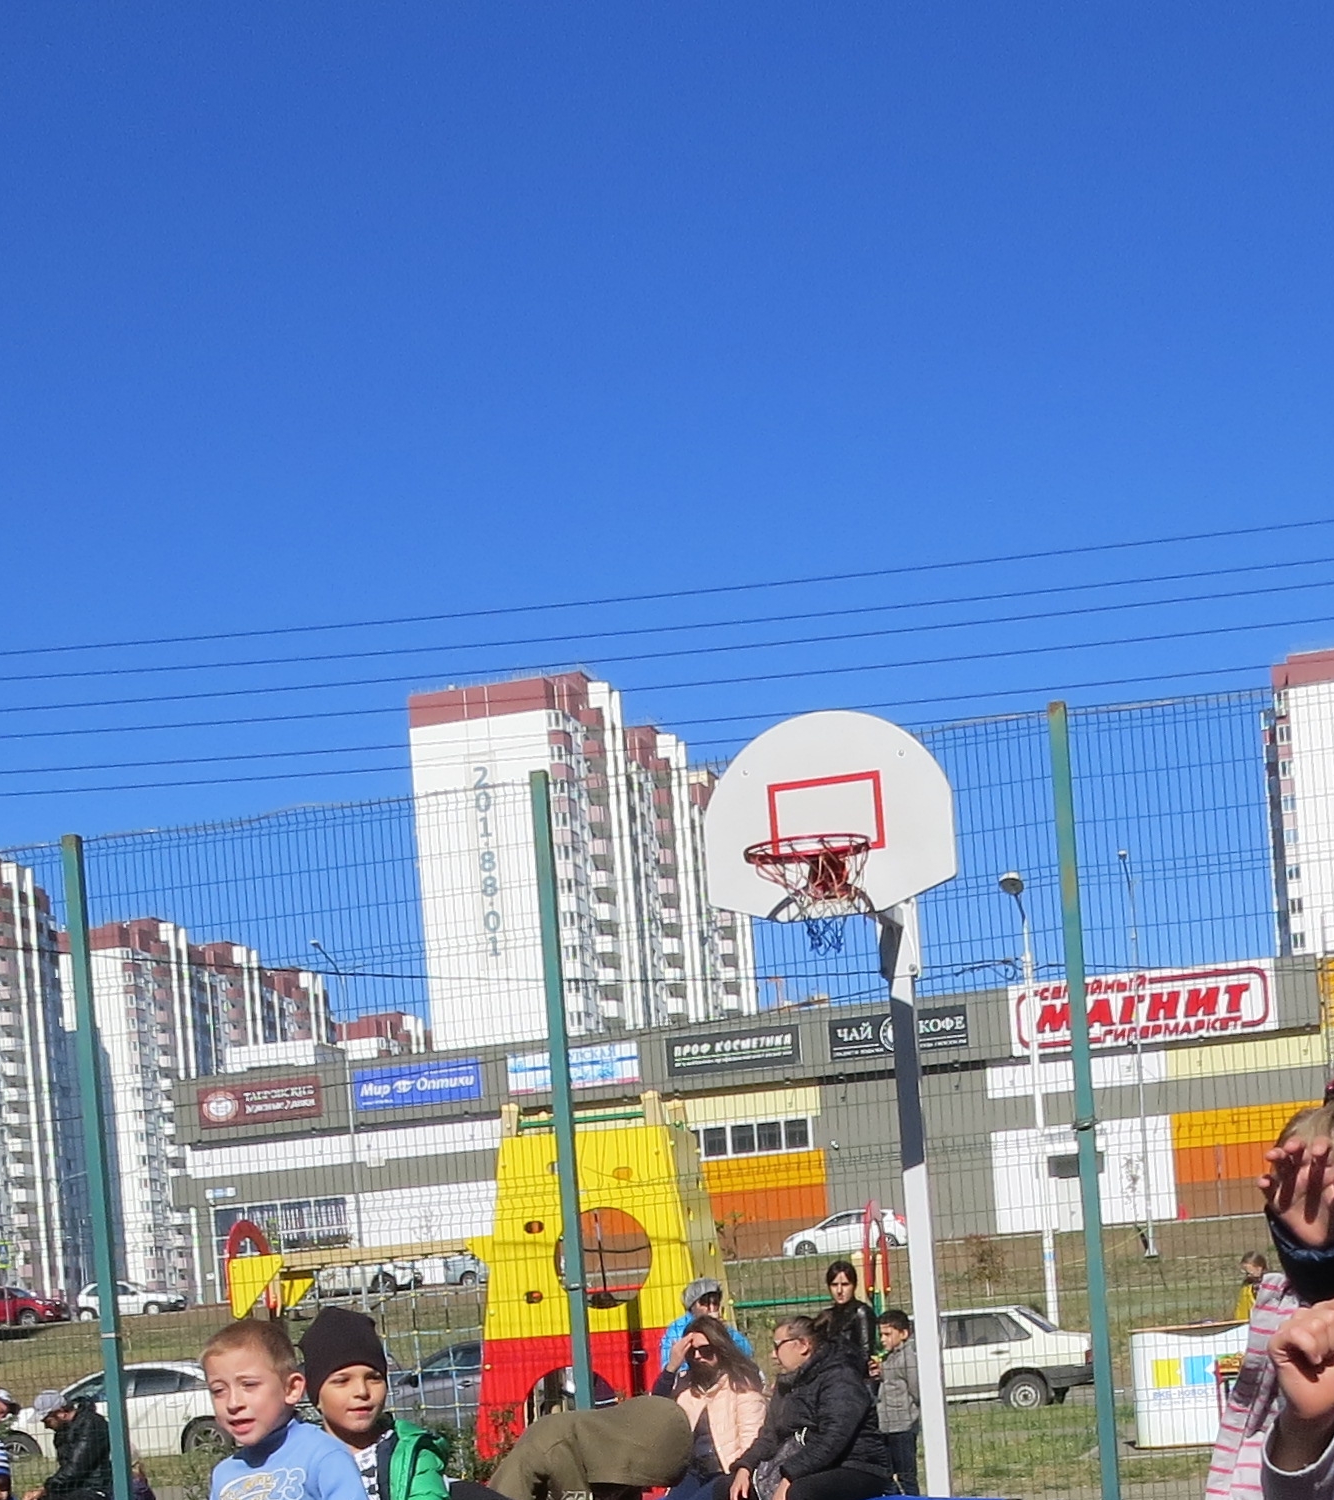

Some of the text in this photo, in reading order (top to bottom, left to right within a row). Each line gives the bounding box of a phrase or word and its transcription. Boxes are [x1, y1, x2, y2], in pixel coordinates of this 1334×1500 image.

[1039, 974, 1147, 1001] СЕЙНЫЙ
[1036, 983, 1251, 1034] МАГНИТ
[836, 1015, 966, 1042] ЧАЙ КОФЕ
[1101, 1015, 1243, 1043] ГИПЕРМАРКЕТ
[673, 1033, 793, 1058] ПРОФ КОСМЕТИКА
[360, 1075, 475, 1098] Мир Оптики
